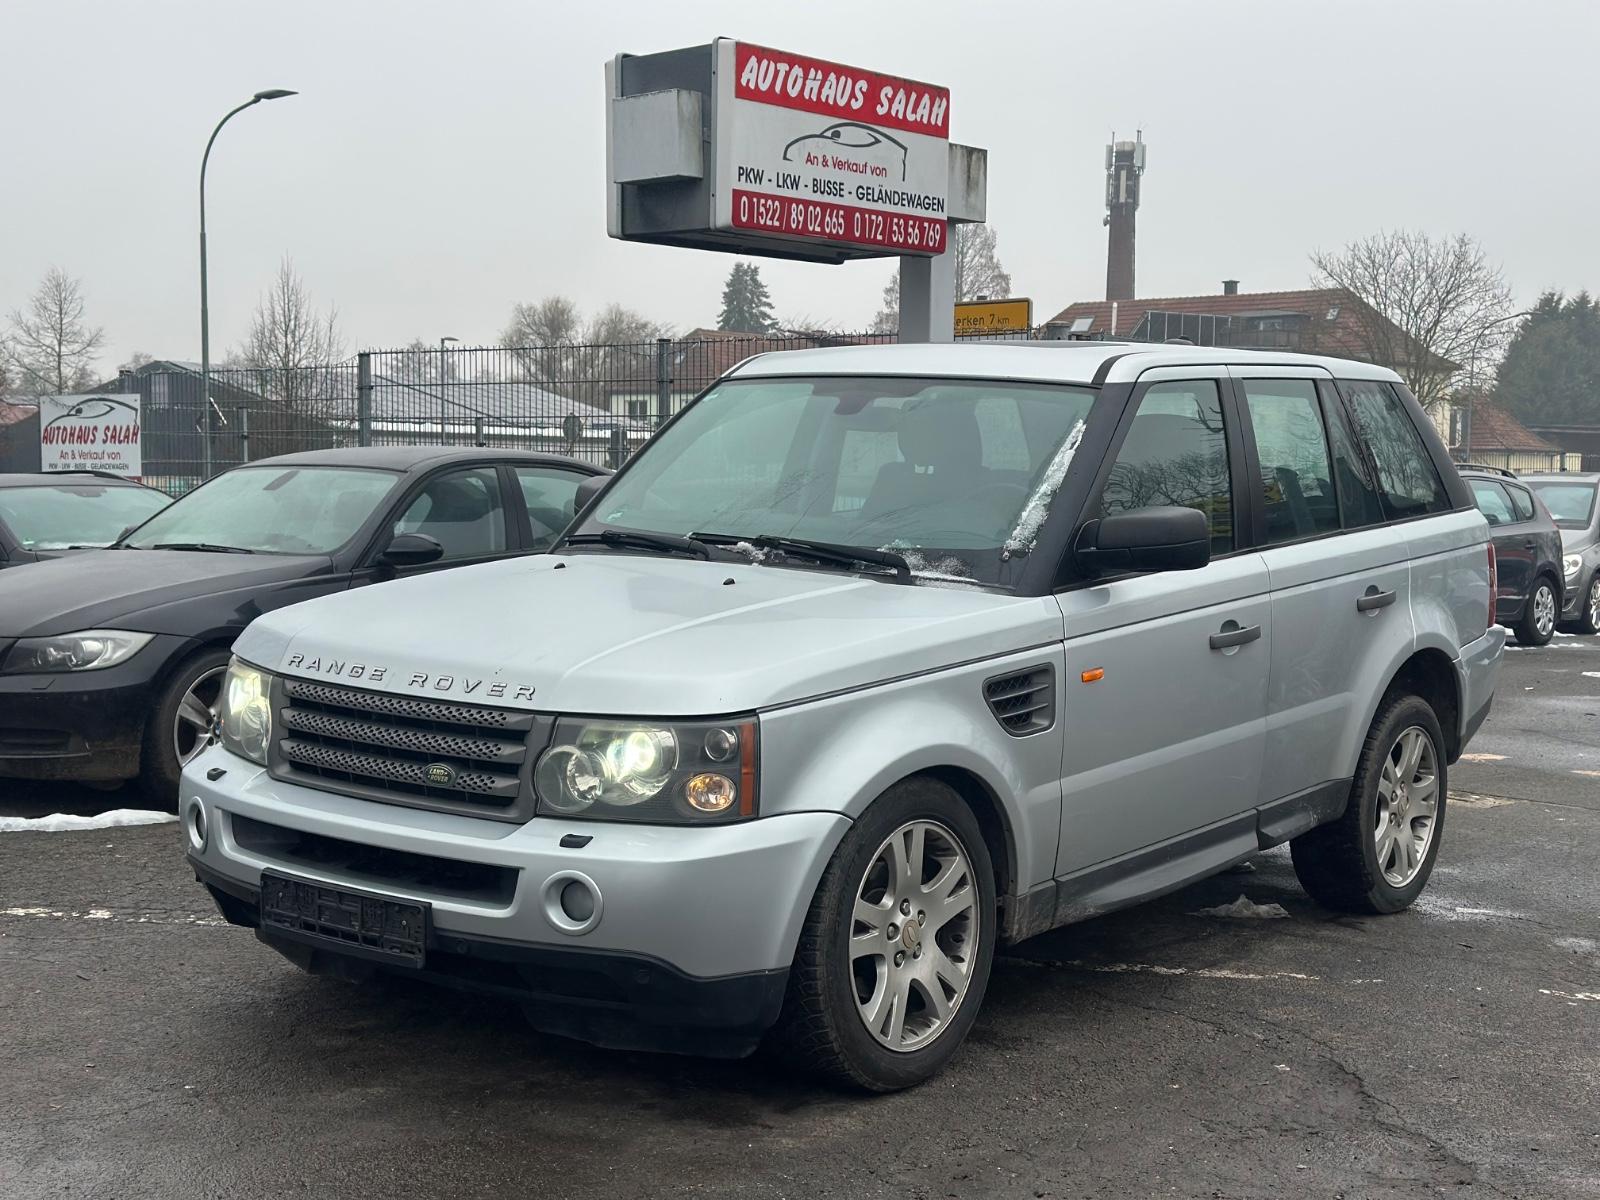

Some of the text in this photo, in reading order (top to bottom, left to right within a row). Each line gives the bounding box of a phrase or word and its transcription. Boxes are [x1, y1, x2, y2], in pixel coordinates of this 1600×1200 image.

[740, 55, 947, 127] AUTOHAUS SALAH
[805, 152, 887, 177] An & Verkauf von
[737, 166, 764, 185] PKW
[776, 172, 800, 190] LKW
[812, 178, 845, 198] BUSSE
[855, 184, 945, 213] GELÄNDEWAGEN
[752, 198, 780, 227] 1522
[790, 203, 804, 229] 89
[807, 205, 821, 232] 02
[824, 208, 845, 235] 665
[864, 213, 883, 240] 172
[892, 217, 904, 243] 53
[907, 220, 920, 245] 56
[923, 222, 941, 247] 769
[989, 313, 996, 325] 7
[997, 316, 1010, 325] km
[42, 424, 140, 445] AUTOHAUS SALAH
[60, 450, 121, 460] An & Verkauf von
[288, 653, 536, 701] RANGE ROVER
[429, 767, 444, 776] LAND
[430, 774, 449, 783] ROVER
